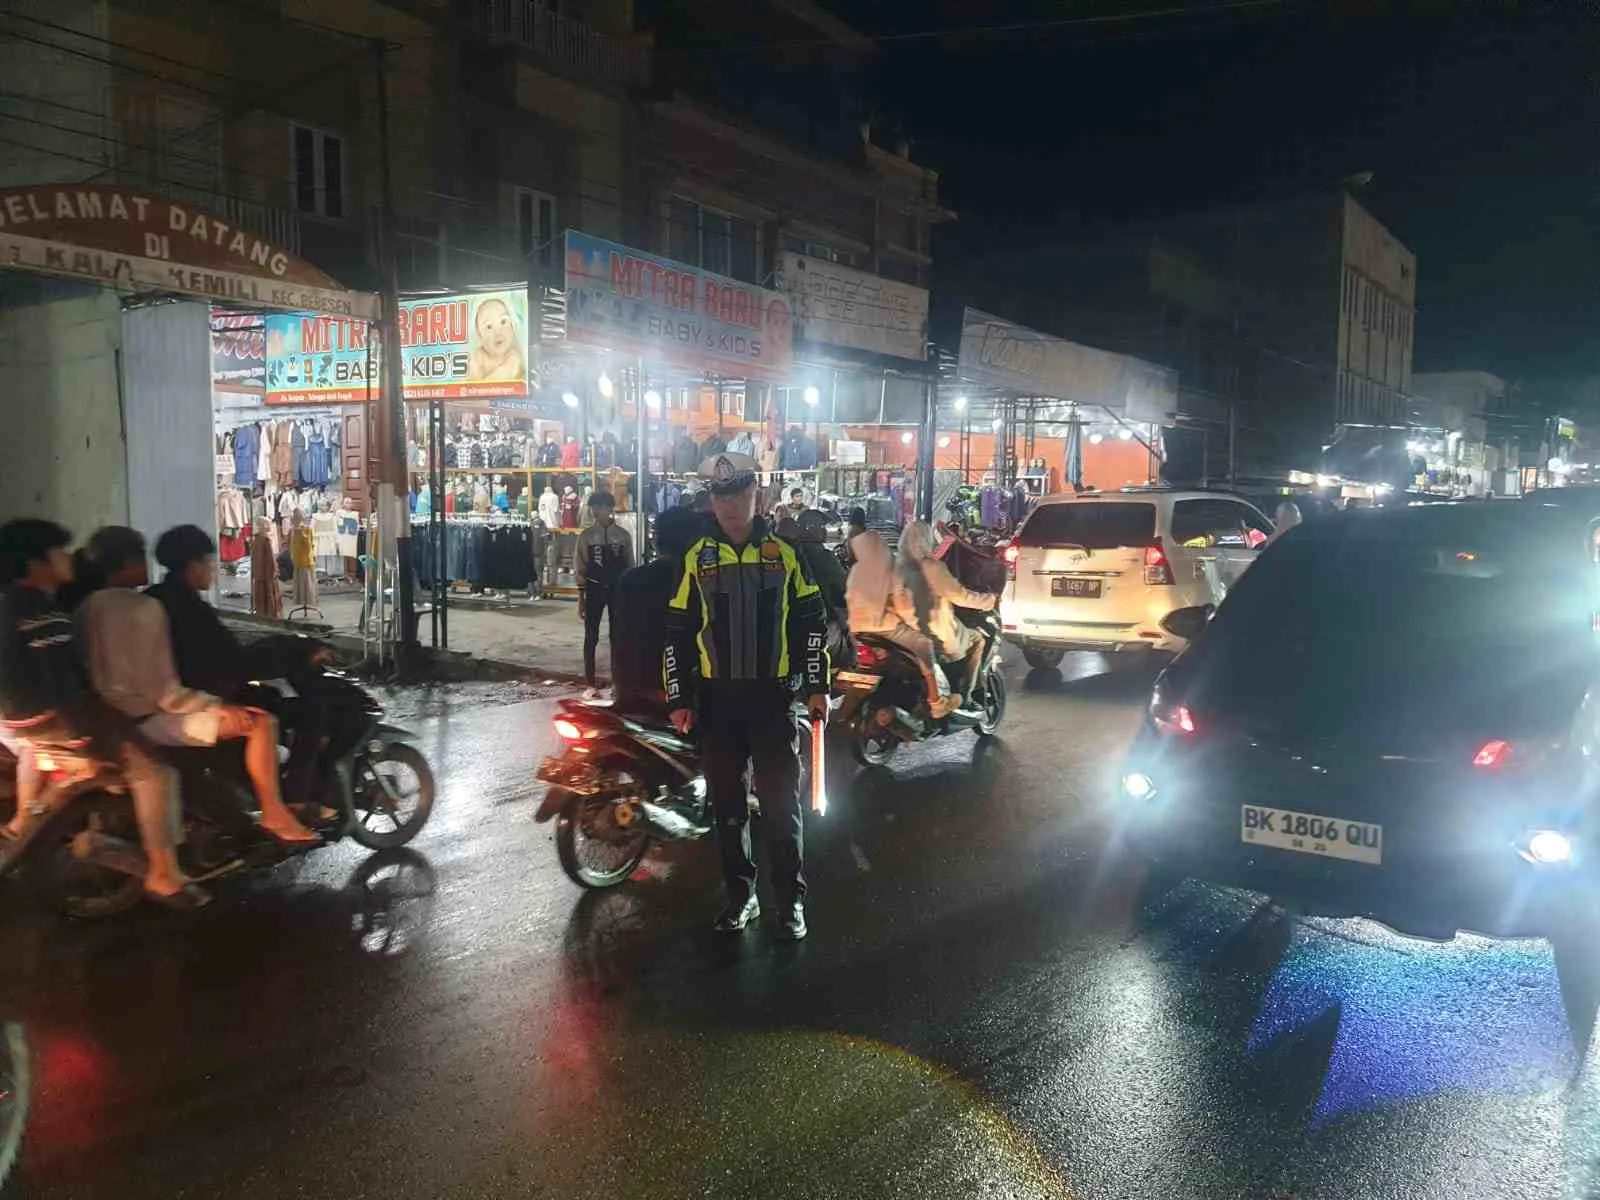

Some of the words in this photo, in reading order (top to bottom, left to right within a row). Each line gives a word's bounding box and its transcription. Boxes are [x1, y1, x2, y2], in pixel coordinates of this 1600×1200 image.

[0, 191, 150, 226] ELAMAT
[170, 205, 288, 276] DATANG
[144, 232, 169, 259] DI
[610, 251, 698, 312] MITRA
[705, 278, 763, 329] BARU
[301, 314, 380, 354] MITR
[648, 317, 701, 342] BABY
[411, 353, 468, 378] KID'S
[807, 632, 821, 684] POLISI
[1244, 807, 1275, 832] BK
[1280, 813, 1339, 841] 1806
[1345, 823, 1378, 848] QU
